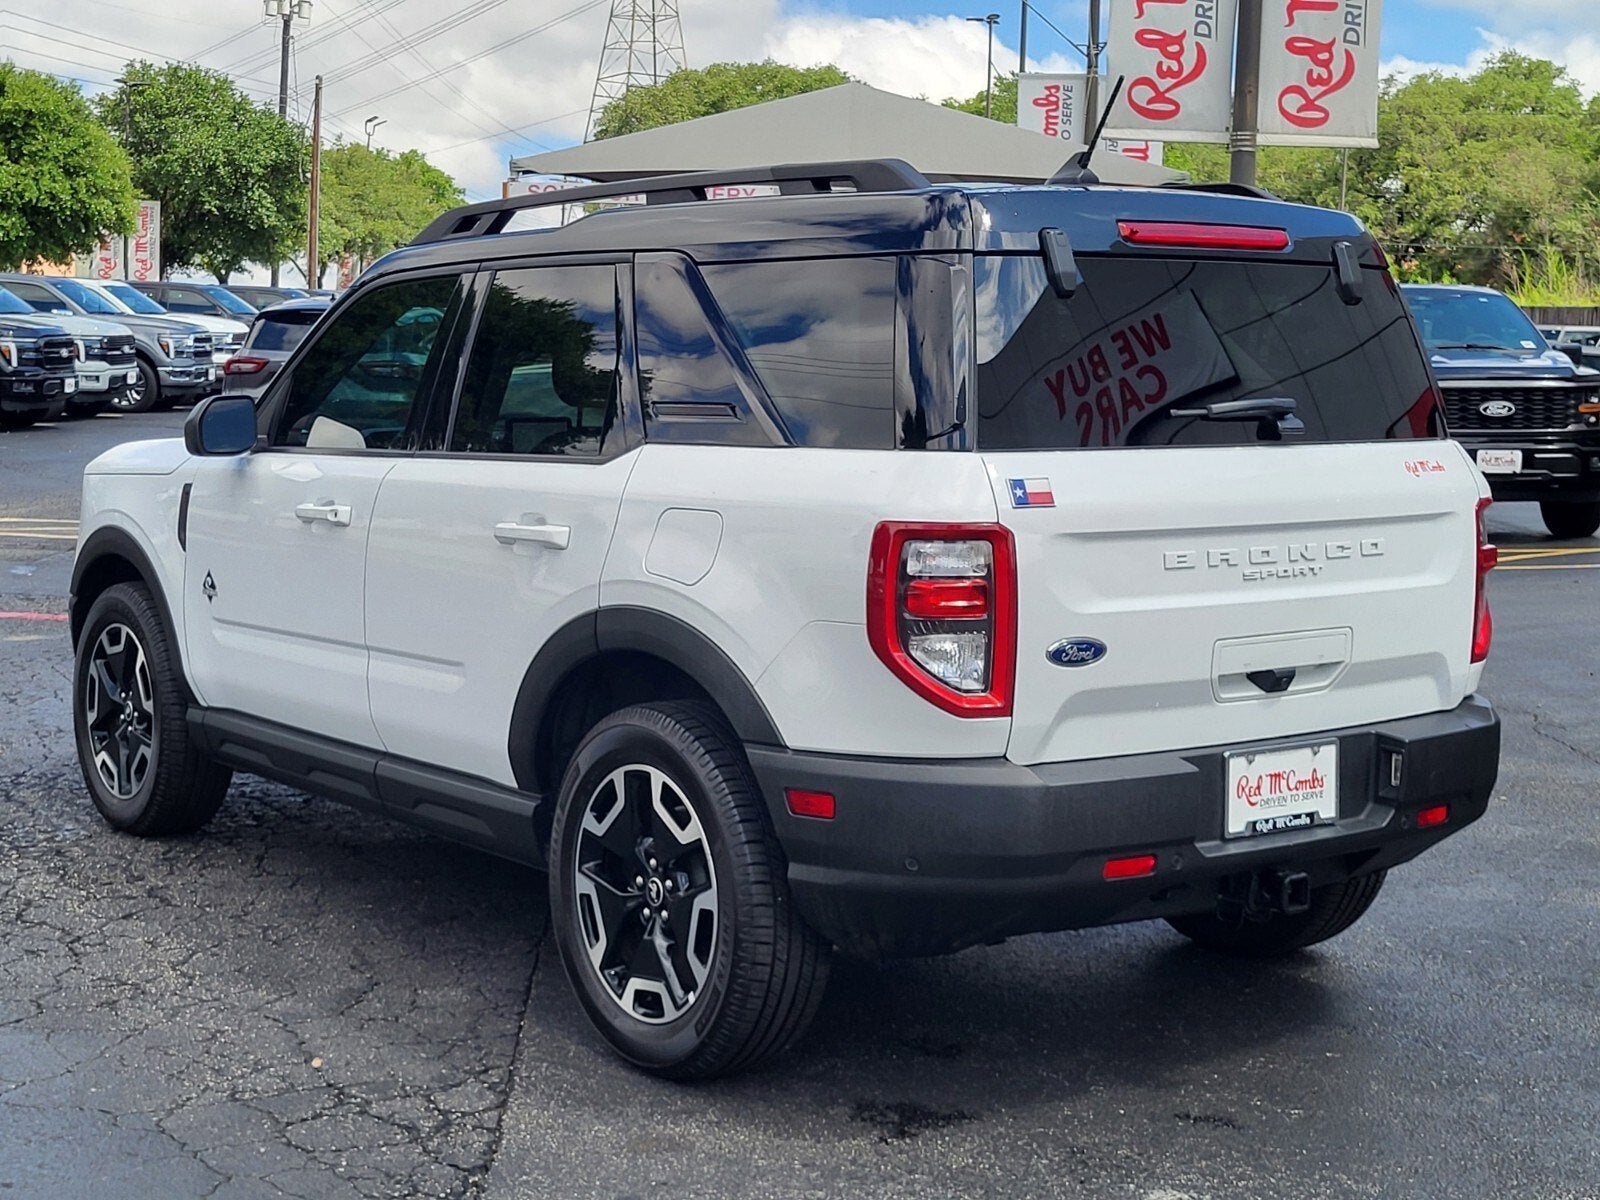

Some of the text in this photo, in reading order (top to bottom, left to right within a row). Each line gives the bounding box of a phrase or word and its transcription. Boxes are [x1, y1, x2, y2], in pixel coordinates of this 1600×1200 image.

[1343, 0, 1363, 46] DRI
[1127, 28, 1207, 121] Red
[1278, 36, 1355, 129] Red
[1061, 85, 1073, 126] SERVE
[98, 256, 117, 279] Red
[134, 258, 153, 281] Red
[1163, 538, 1385, 570] BRONCO
[1242, 565, 1323, 581] SPORT
[1236, 775, 1263, 807] Red
[1259, 790, 1324, 808] DRIVEN TO SERVE
[1256, 820, 1274, 833] Red
